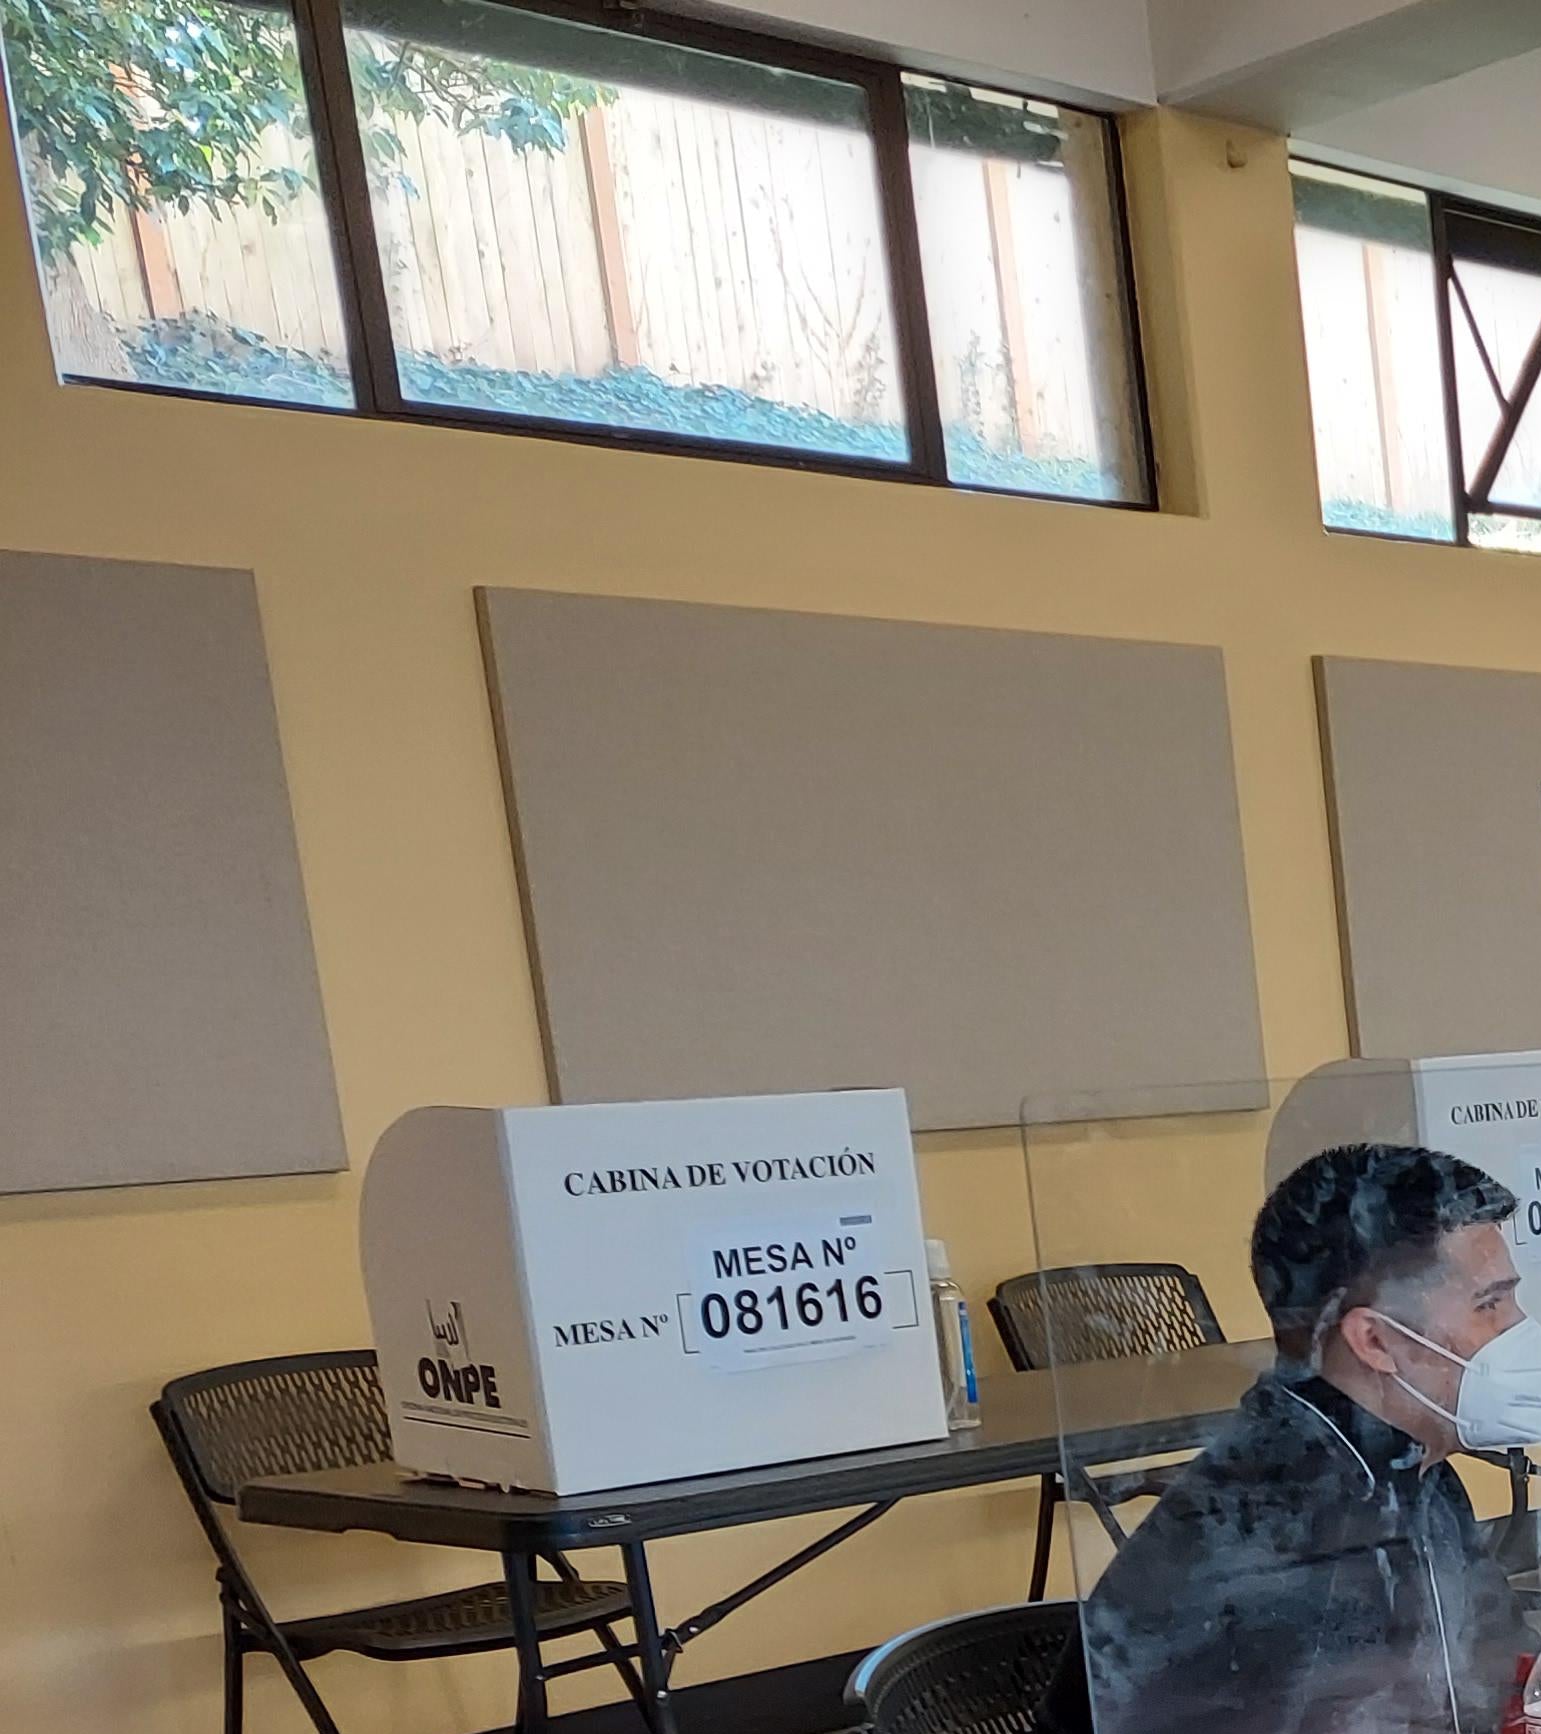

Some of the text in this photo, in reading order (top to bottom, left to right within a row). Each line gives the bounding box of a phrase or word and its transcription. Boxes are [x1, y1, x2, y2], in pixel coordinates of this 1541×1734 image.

[1451, 1102, 1514, 1126] CABINA
[1517, 1099, 1539, 1119] DE
[564, 1147, 876, 1197] CABINA DE VOTACIÓN
[713, 1242, 814, 1279] MESA
[700, 1275, 882, 1339] 081616
[553, 1318, 636, 1347] MESA
[418, 1357, 502, 1409] ONPE
